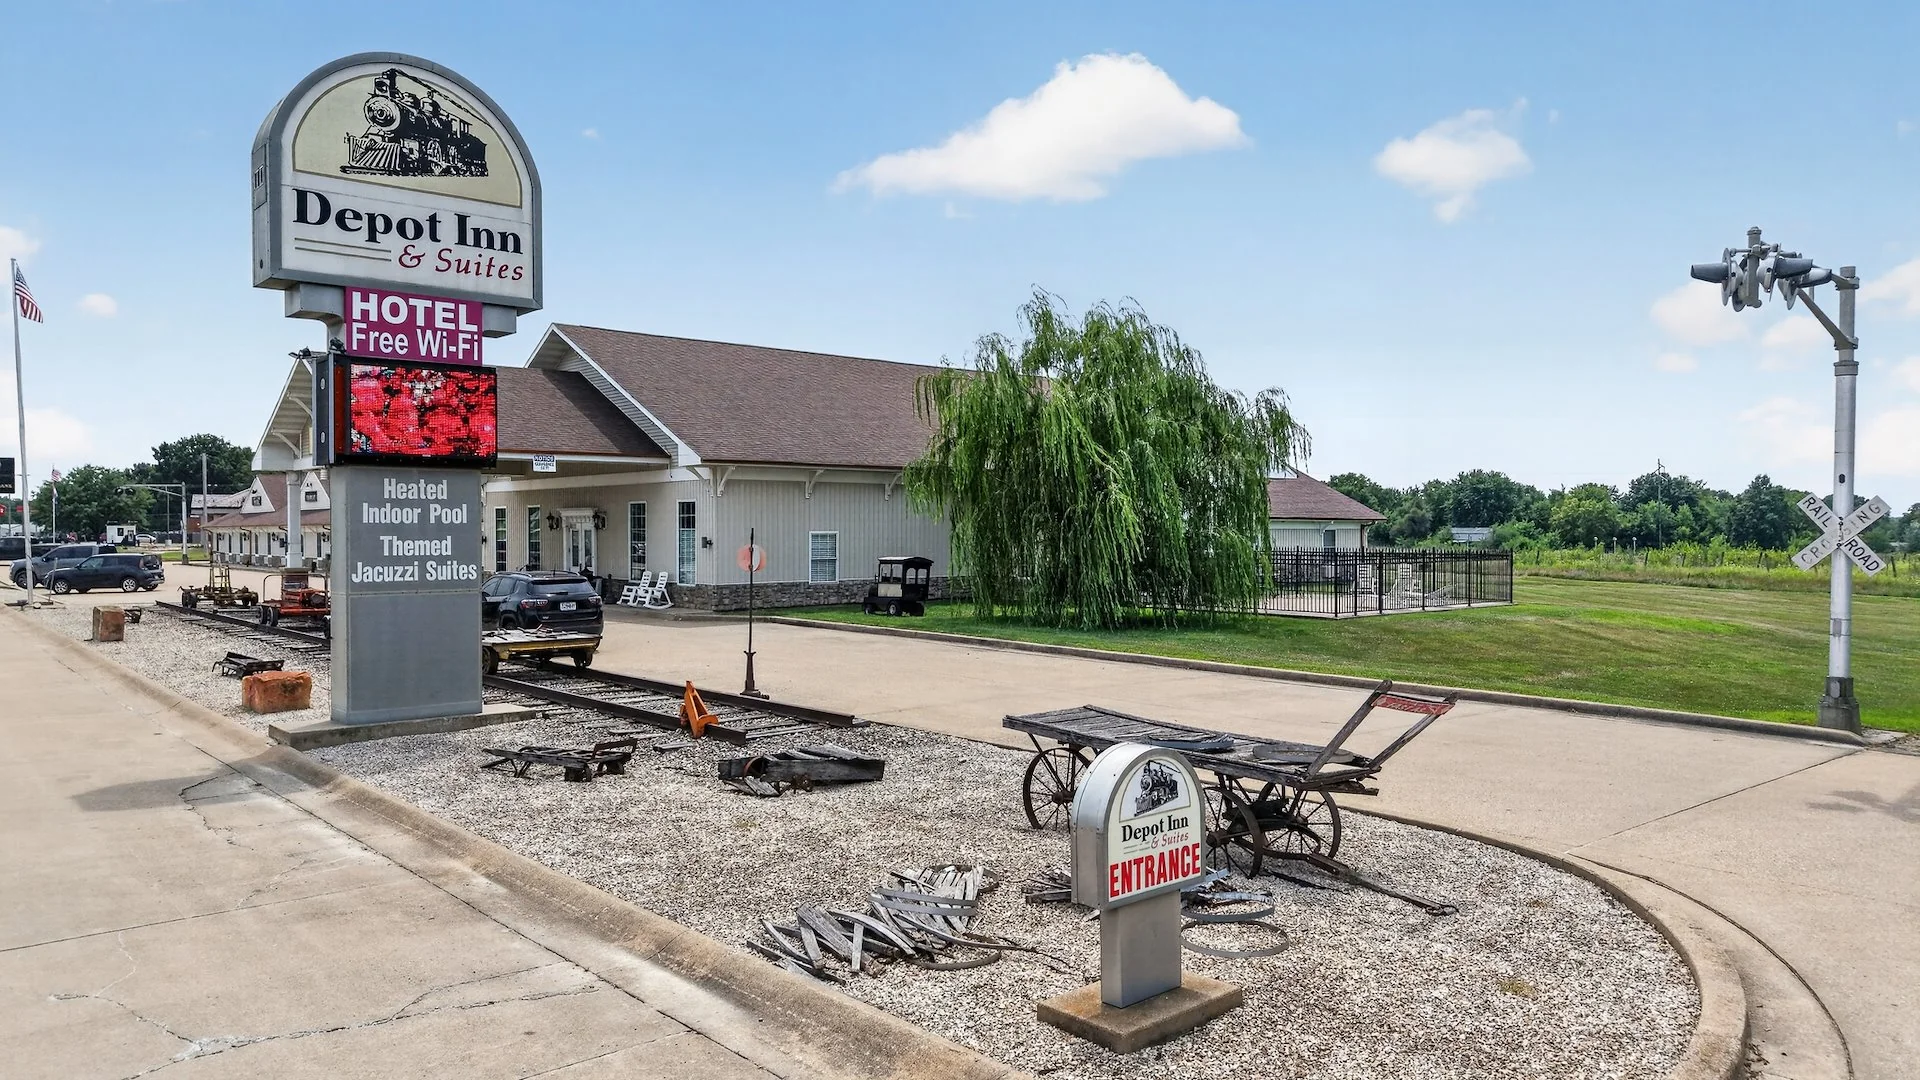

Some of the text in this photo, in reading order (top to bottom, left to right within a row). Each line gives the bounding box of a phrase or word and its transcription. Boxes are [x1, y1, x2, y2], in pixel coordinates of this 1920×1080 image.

[292, 187, 523, 255] Depot Inn
[398, 244, 524, 281] & Suites
[352, 291, 478, 332] HOTEL
[351, 322, 479, 361] Free Wi-Fi
[383, 477, 448, 500] Heated
[362, 502, 468, 524] Indoor Pool
[379, 535, 452, 557] Themed
[1802, 496, 1880, 571] RAIL ROAD
[351, 560, 478, 583] Jacuzzi Suites
[1122, 815, 1188, 842] Depot Inn
[1150, 831, 1188, 849] & Suites
[1109, 842, 1201, 898] ENTRANCE
